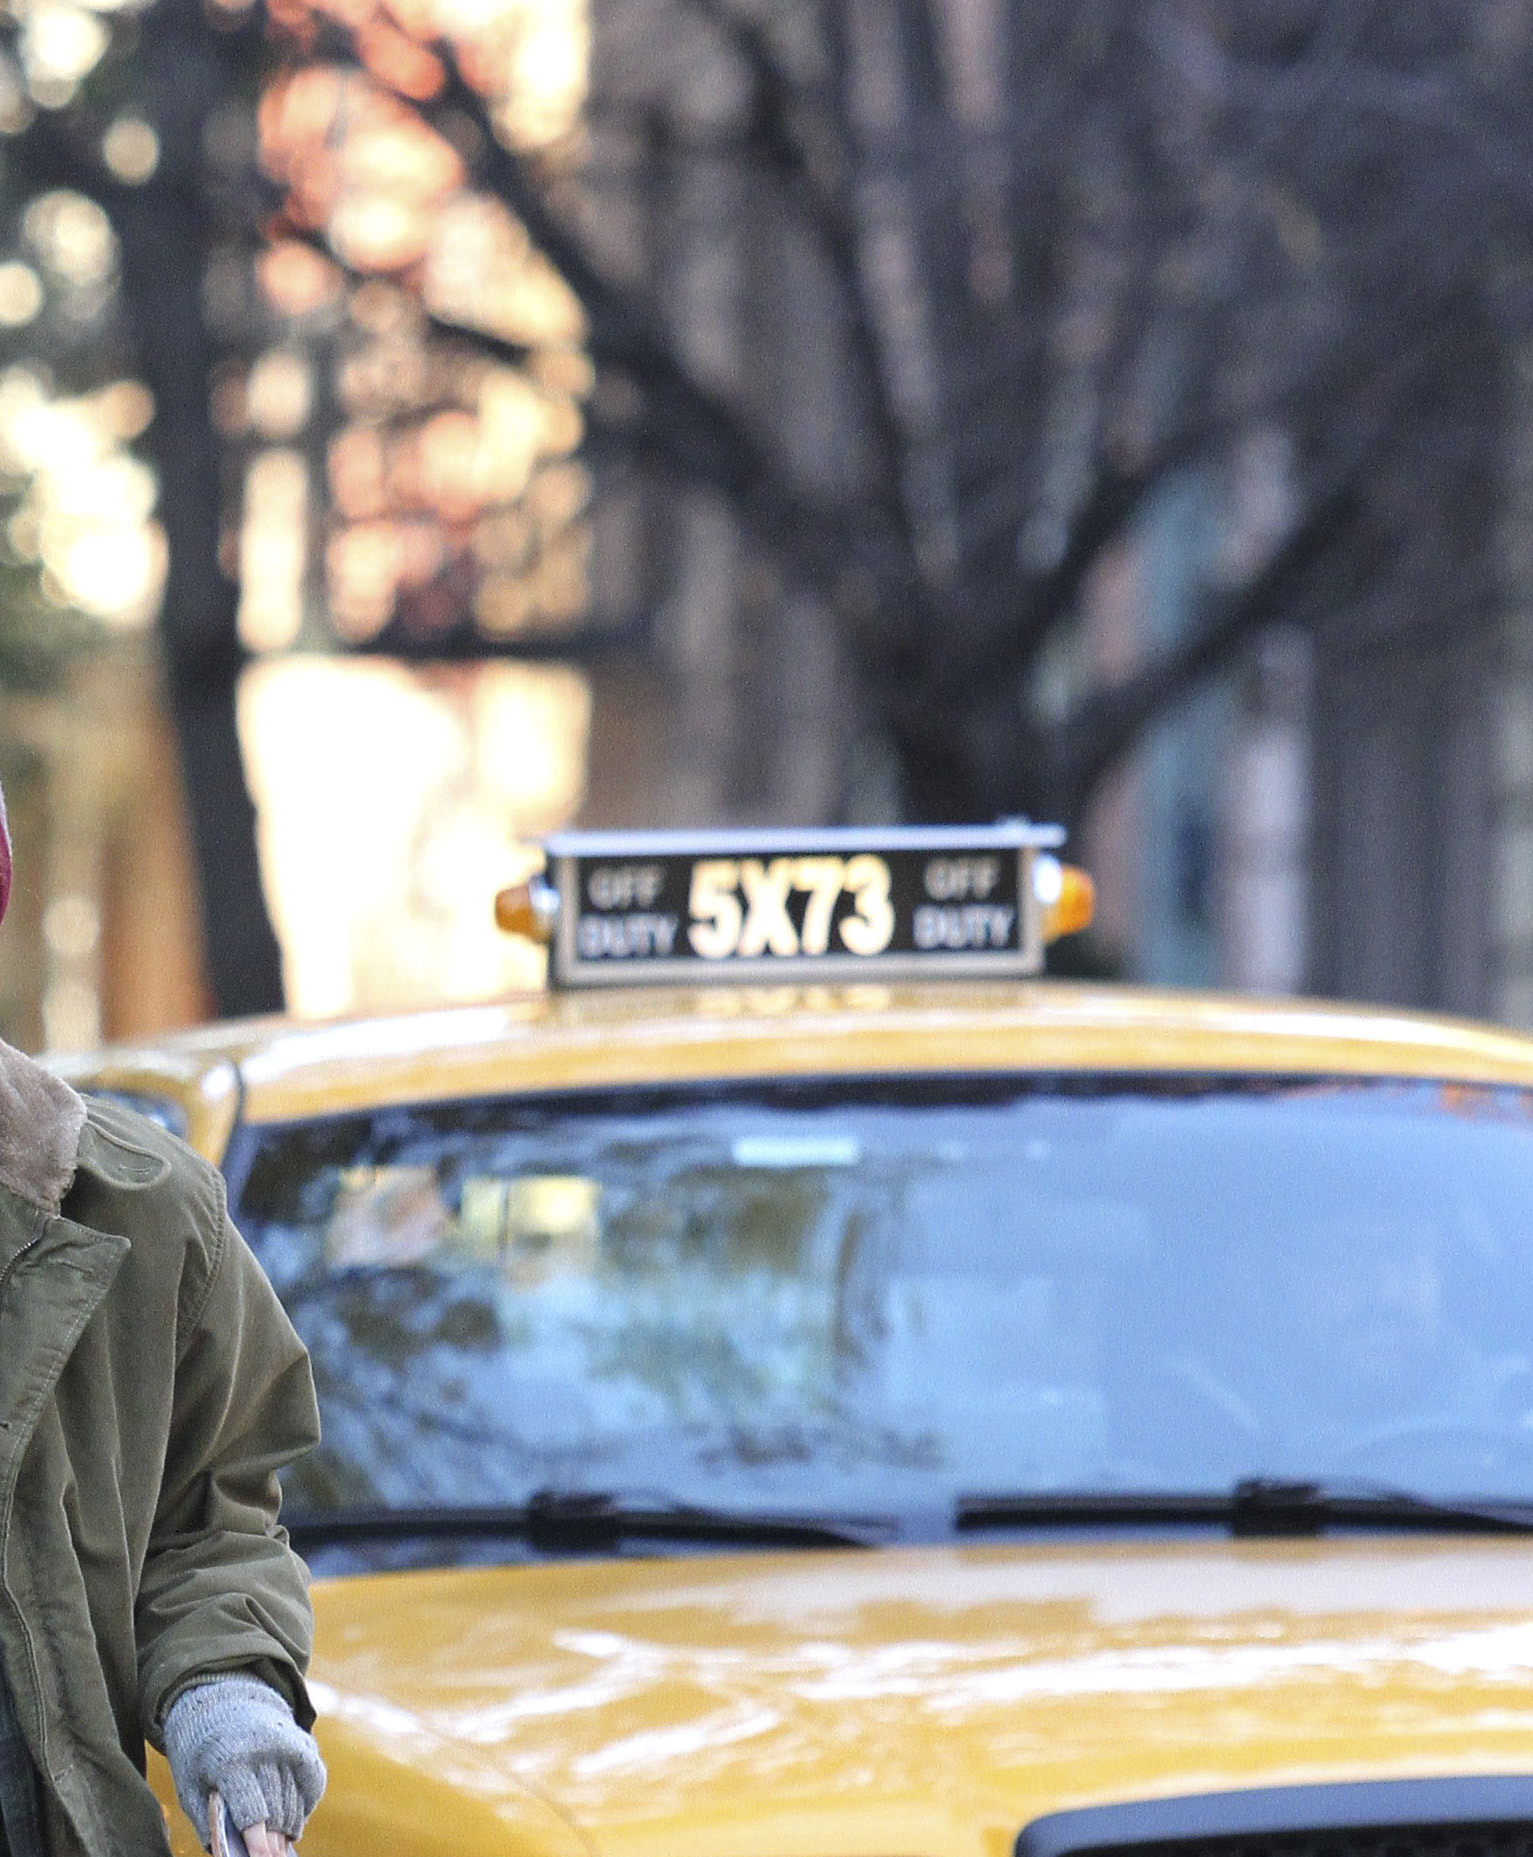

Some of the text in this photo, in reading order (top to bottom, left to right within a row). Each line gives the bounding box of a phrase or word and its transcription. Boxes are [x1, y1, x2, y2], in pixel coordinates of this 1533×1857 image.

[588, 866, 664, 910] OFF
[924, 856, 999, 900] OFF
[687, 854, 895, 959] 5X73
